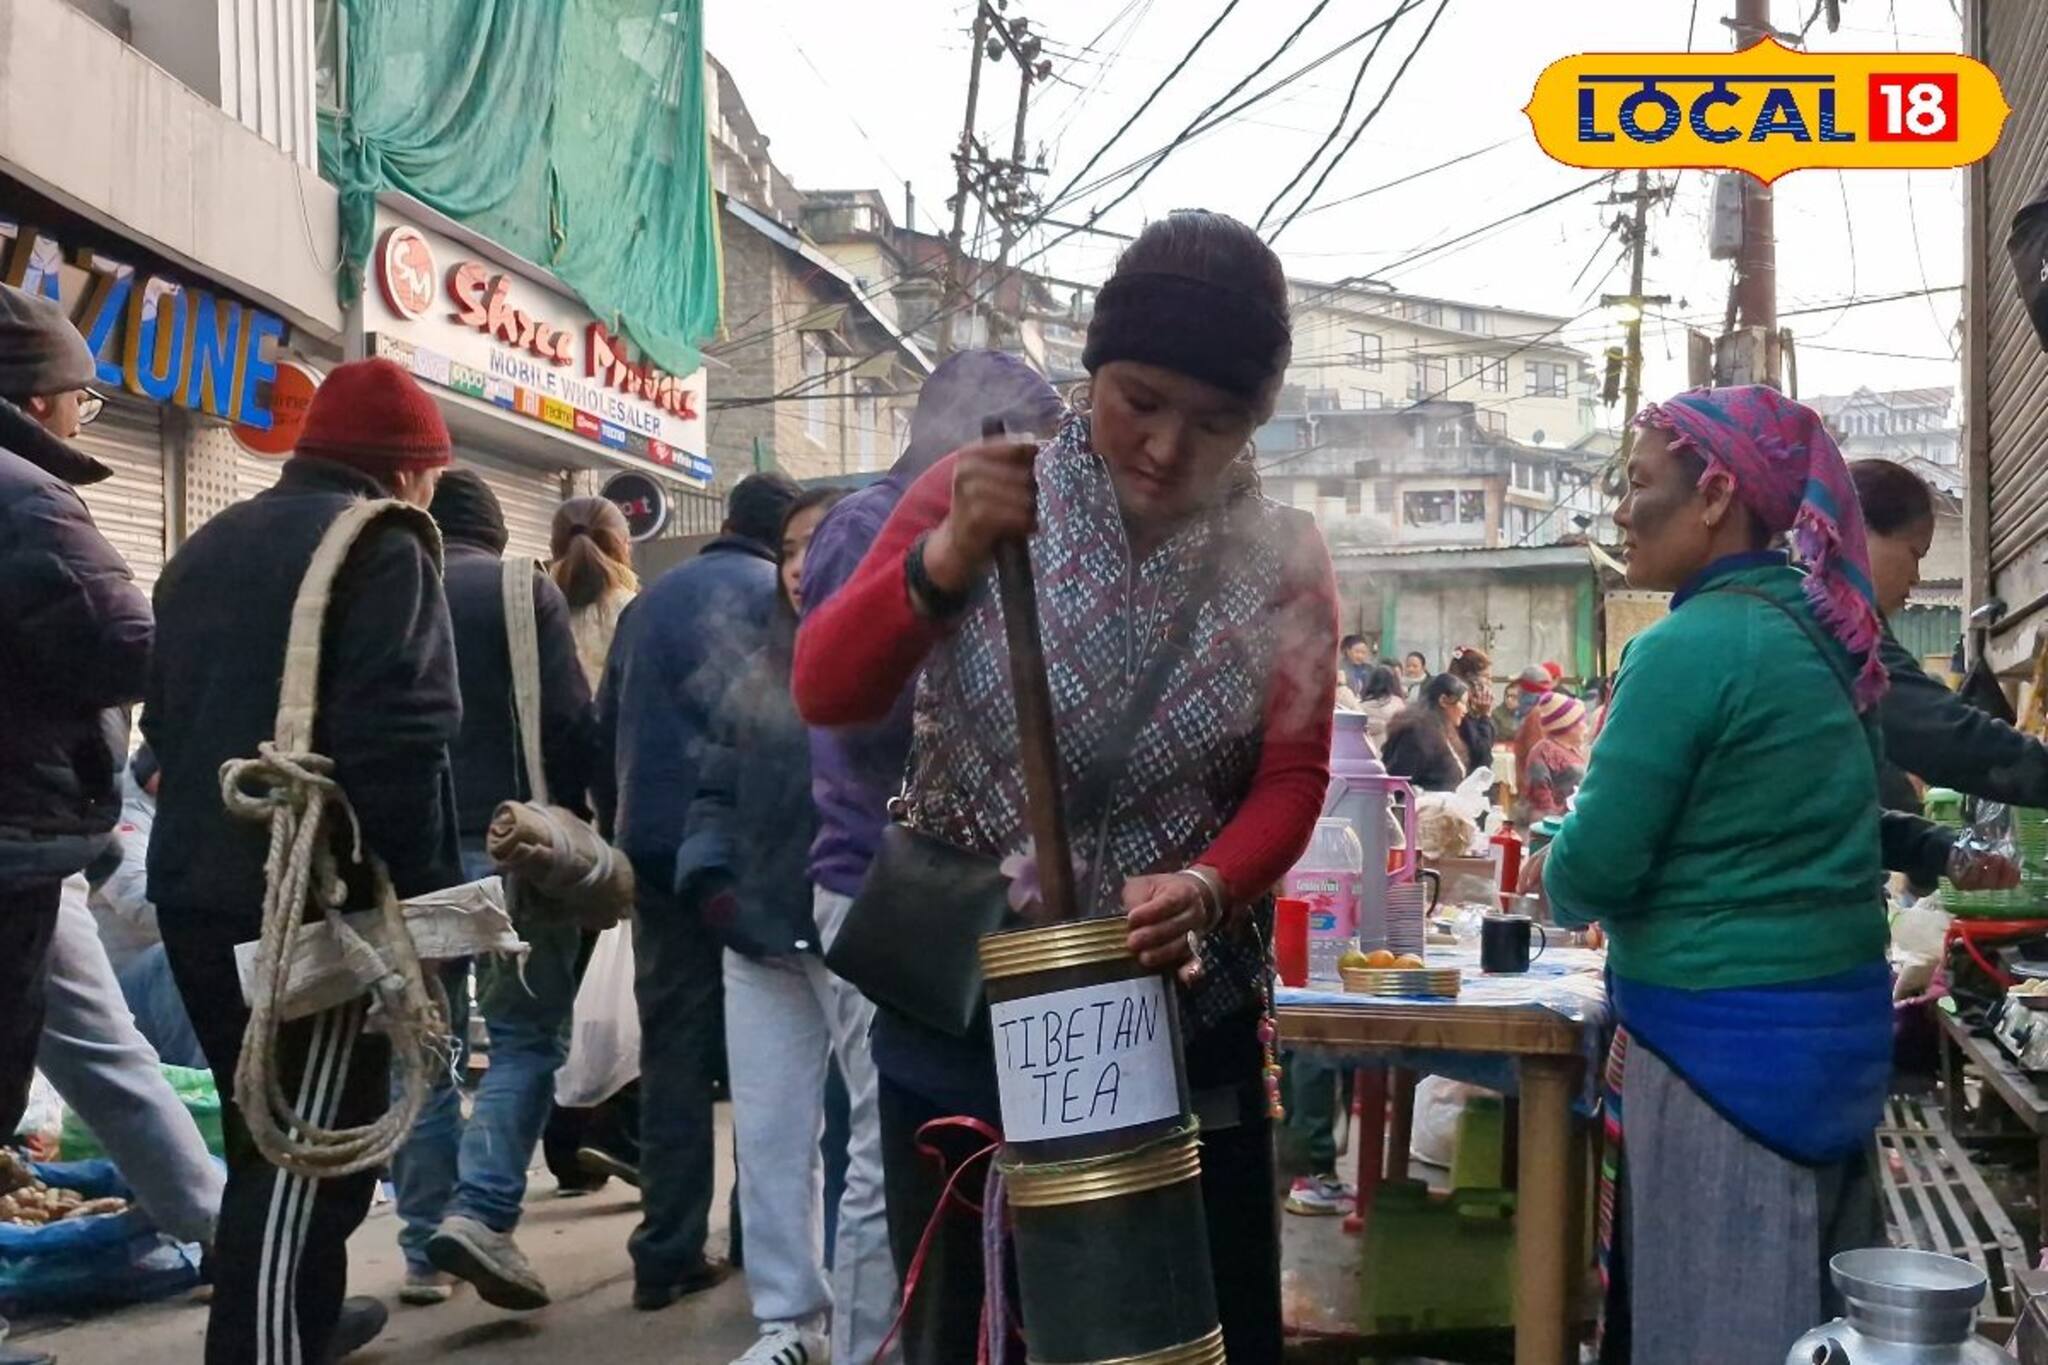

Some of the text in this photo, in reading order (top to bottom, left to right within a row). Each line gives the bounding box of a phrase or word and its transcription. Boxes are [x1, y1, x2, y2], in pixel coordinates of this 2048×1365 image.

[489, 344, 661, 435] MOBILE WHOLESALER
[998, 994, 1161, 1071] TIBETAN
[1032, 1061, 1121, 1125] TEA
